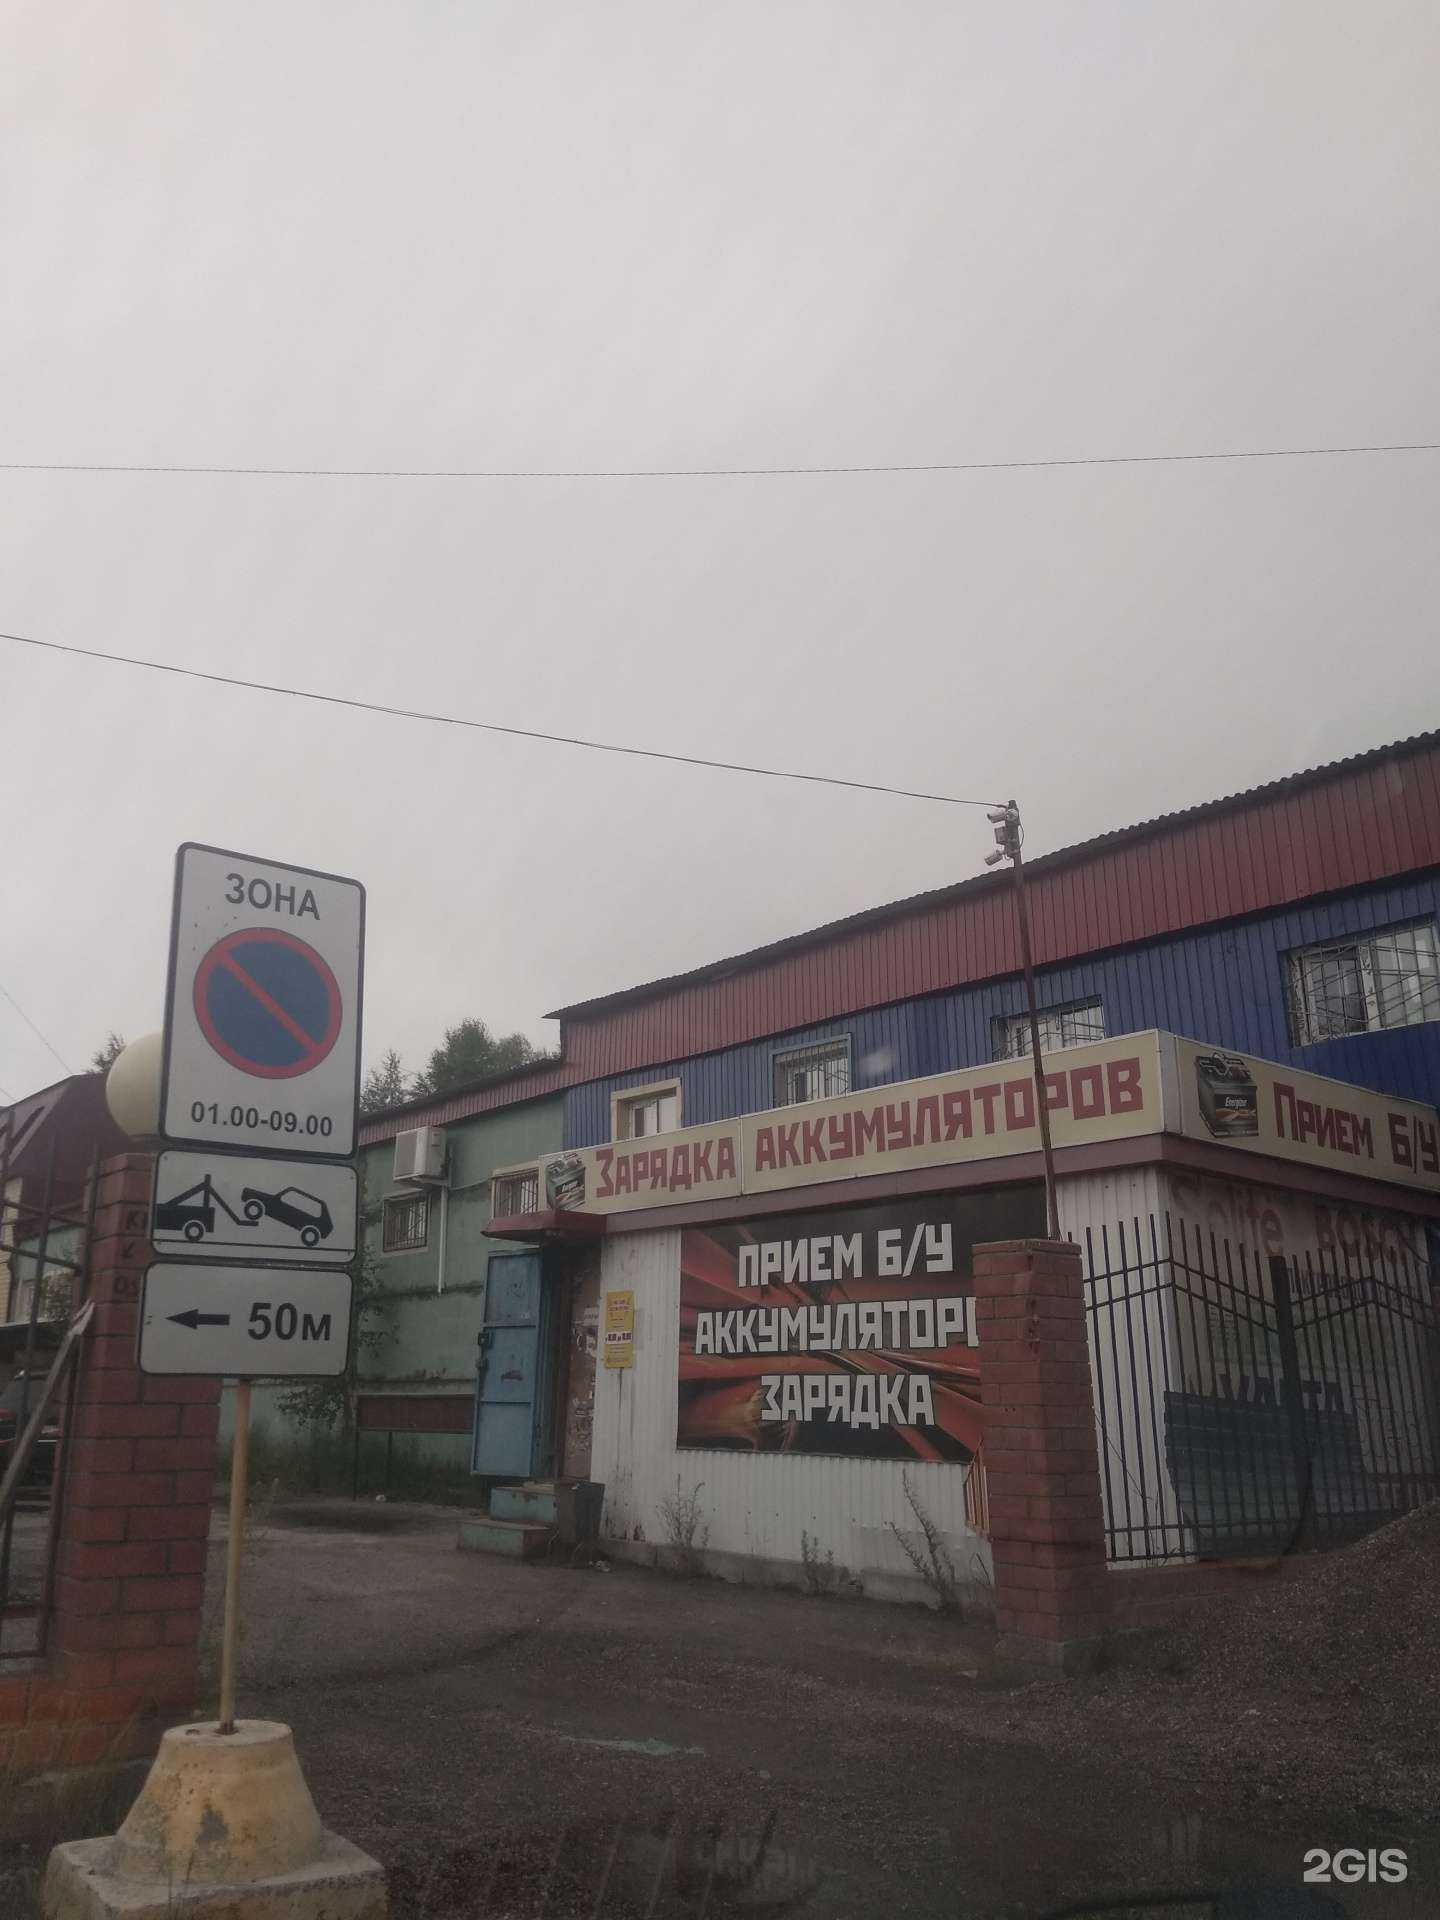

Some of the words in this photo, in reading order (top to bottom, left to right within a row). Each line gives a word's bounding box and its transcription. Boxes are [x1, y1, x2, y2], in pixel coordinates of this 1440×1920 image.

[225, 872, 321, 920] ЗОНА
[190, 1100, 333, 1137] 01.00-09.00
[595, 1136, 737, 1198] ЗАРЯДКА
[755, 1057, 1143, 1171] АККУМУЛЯТОРОВ
[1388, 1112, 1439, 1174] Б/У
[737, 1232, 863, 1288] ПРИЕМ
[878, 1222, 953, 1278] Б/У
[760, 1374, 935, 1430] ЗАРЯДКА
